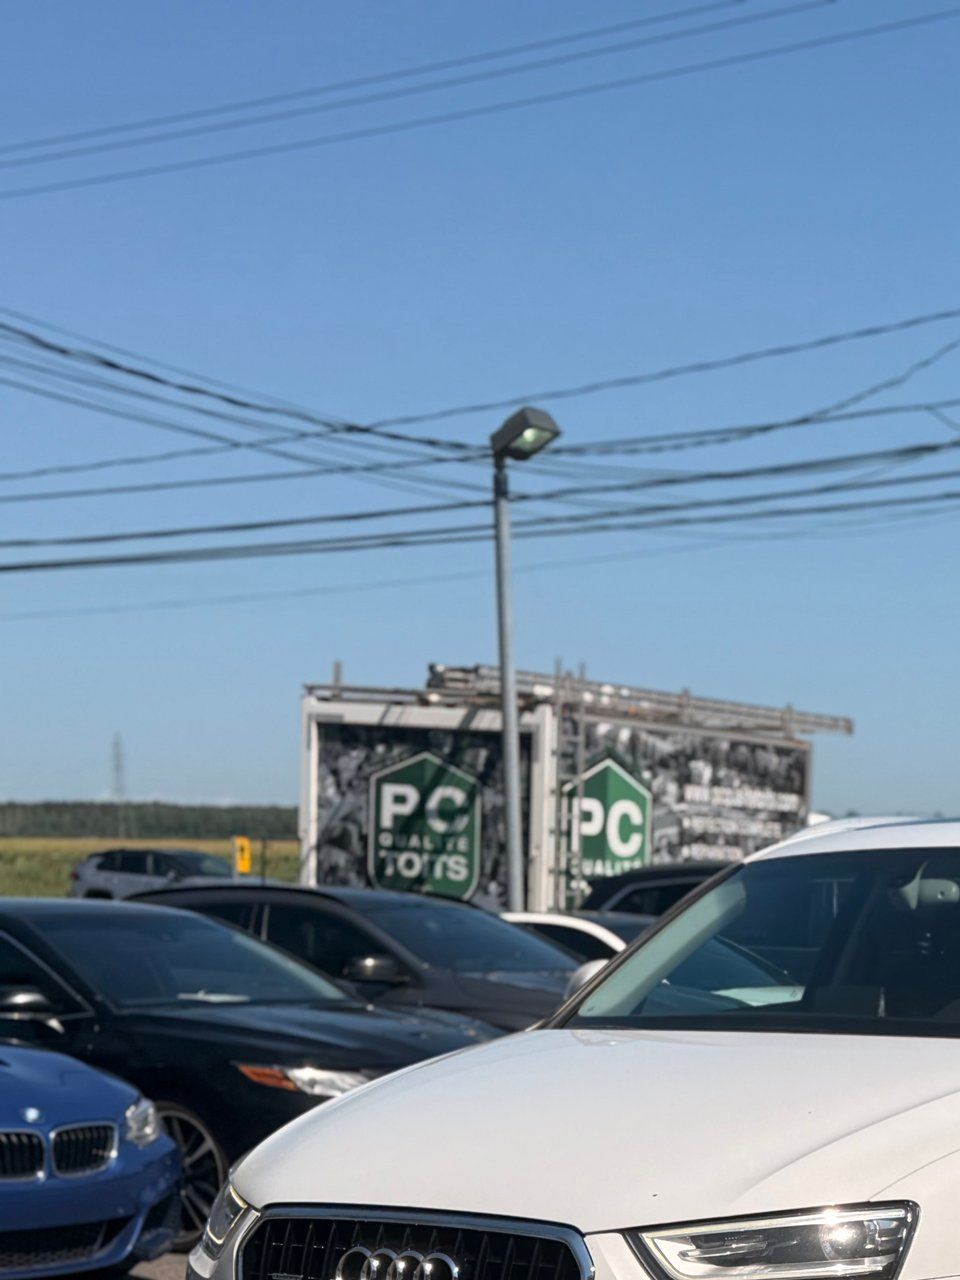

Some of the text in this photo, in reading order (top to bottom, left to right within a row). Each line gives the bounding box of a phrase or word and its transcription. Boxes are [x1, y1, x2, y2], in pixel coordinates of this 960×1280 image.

[380, 783, 469, 833] PC
[571, 797, 643, 857] PC
[378, 850, 469, 882] TOITS
